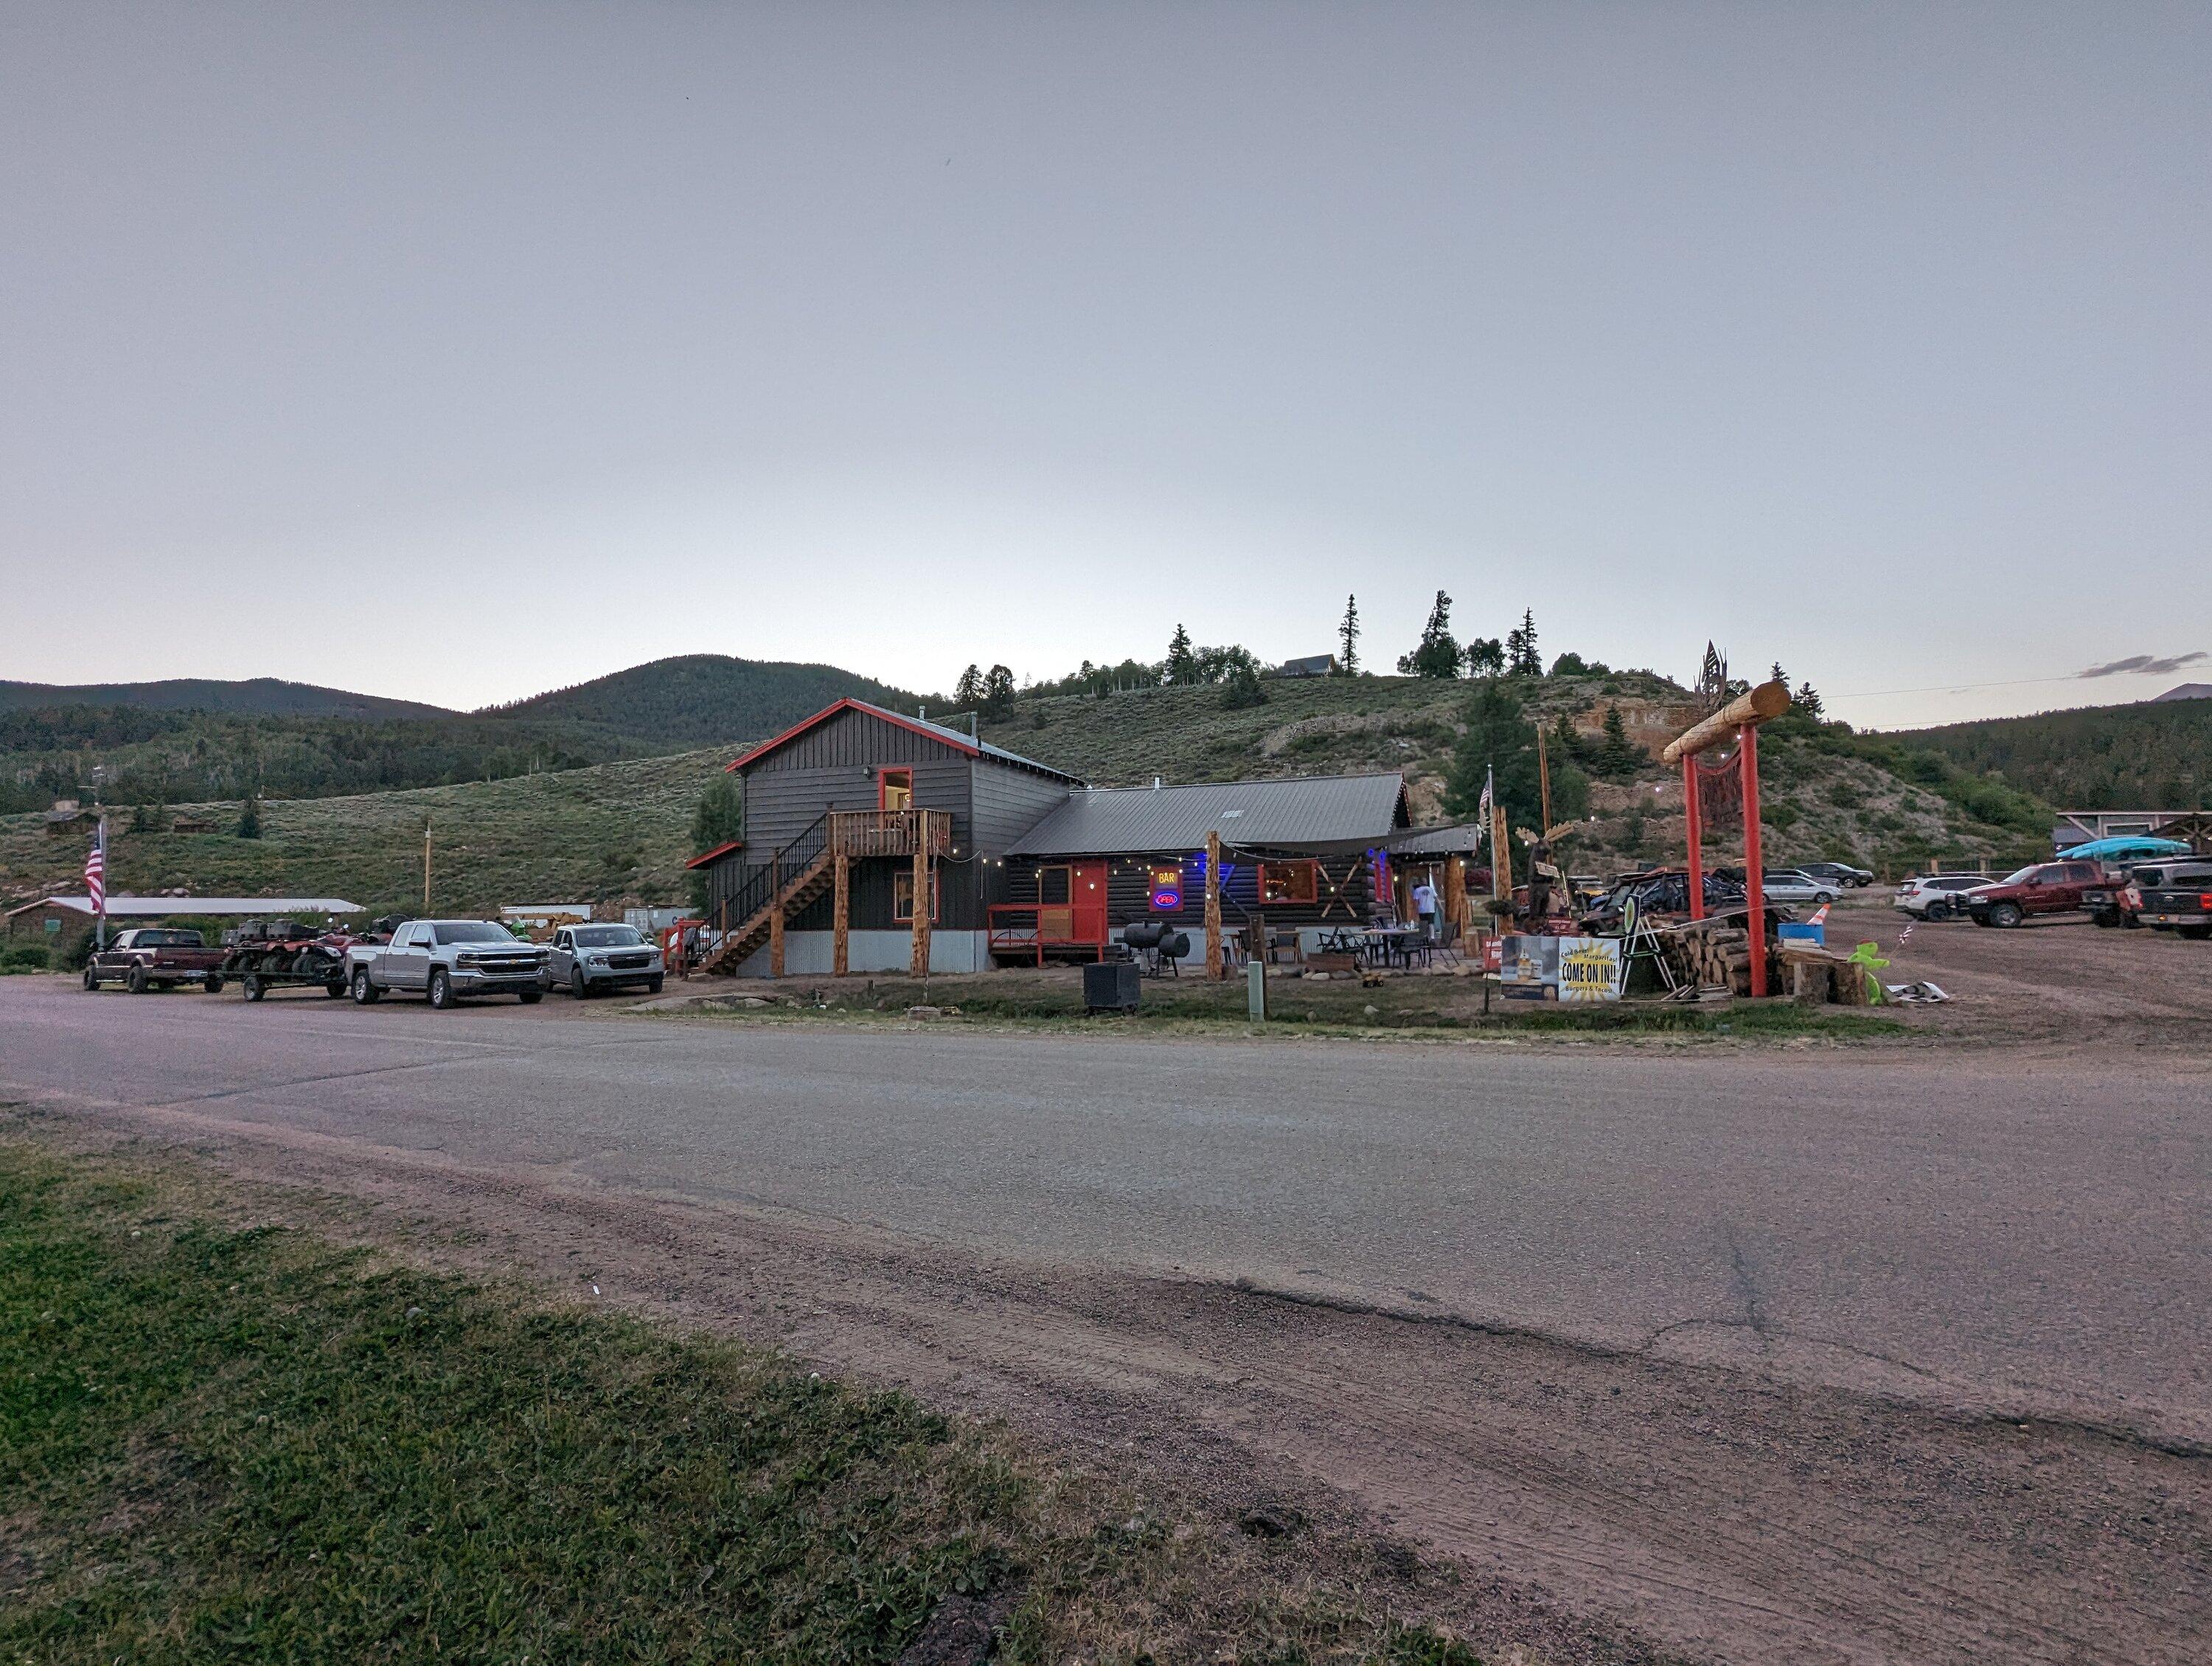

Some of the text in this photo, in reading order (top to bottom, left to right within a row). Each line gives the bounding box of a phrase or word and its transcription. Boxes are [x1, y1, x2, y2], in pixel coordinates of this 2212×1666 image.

[1158, 872, 1175, 884] BAR
[1157, 895, 1175, 903] OPEN
[1583, 954, 1618, 962] Margaritas!
[1562, 962, 1585, 982] COME
[1587, 963, 1599, 983] ON
[1601, 964, 1616, 984] IN!!
